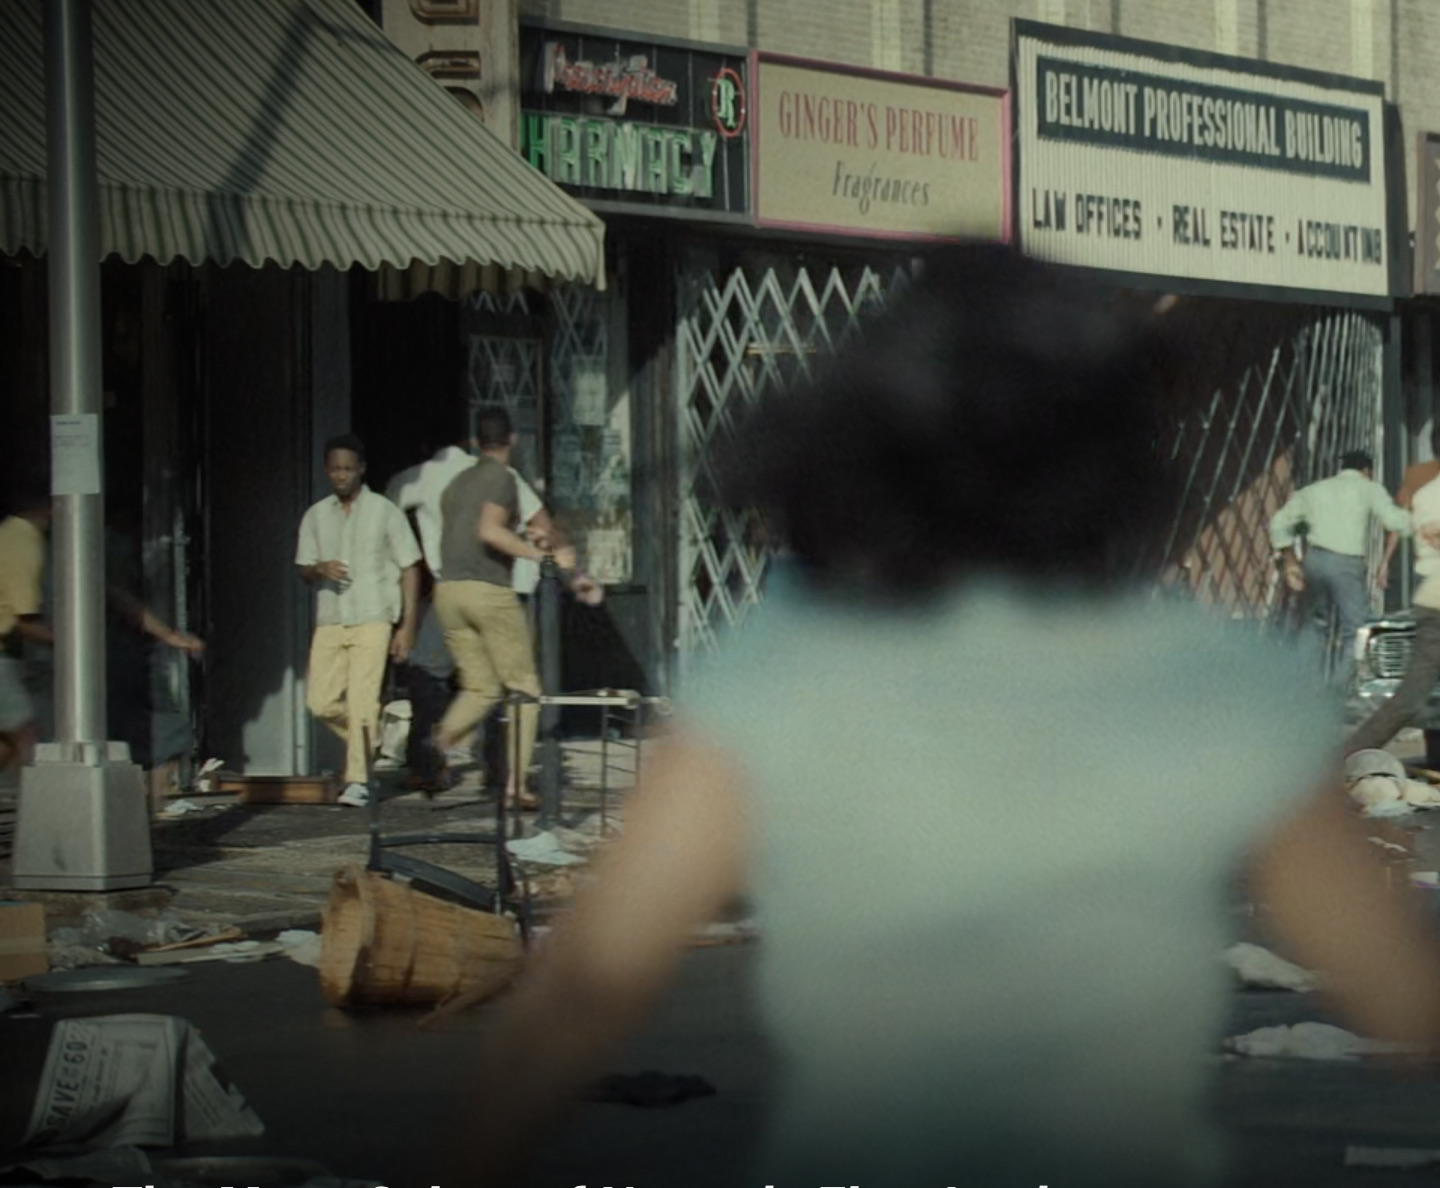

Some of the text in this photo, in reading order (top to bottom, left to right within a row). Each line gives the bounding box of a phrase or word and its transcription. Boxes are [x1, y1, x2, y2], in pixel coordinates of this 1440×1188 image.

[521, 113, 717, 197] HARMACY
[779, 91, 978, 161] GINGER'S PERFUME
[1045, 71, 1362, 169] BELMONT PROFESSIONAL BUILDING
[832, 160, 929, 215] Fragrances
[1033, 188, 1382, 265] LAW OFFICES REAL ESTATE ACCOUNTING
[46, 1080, 79, 1127] SAVE
